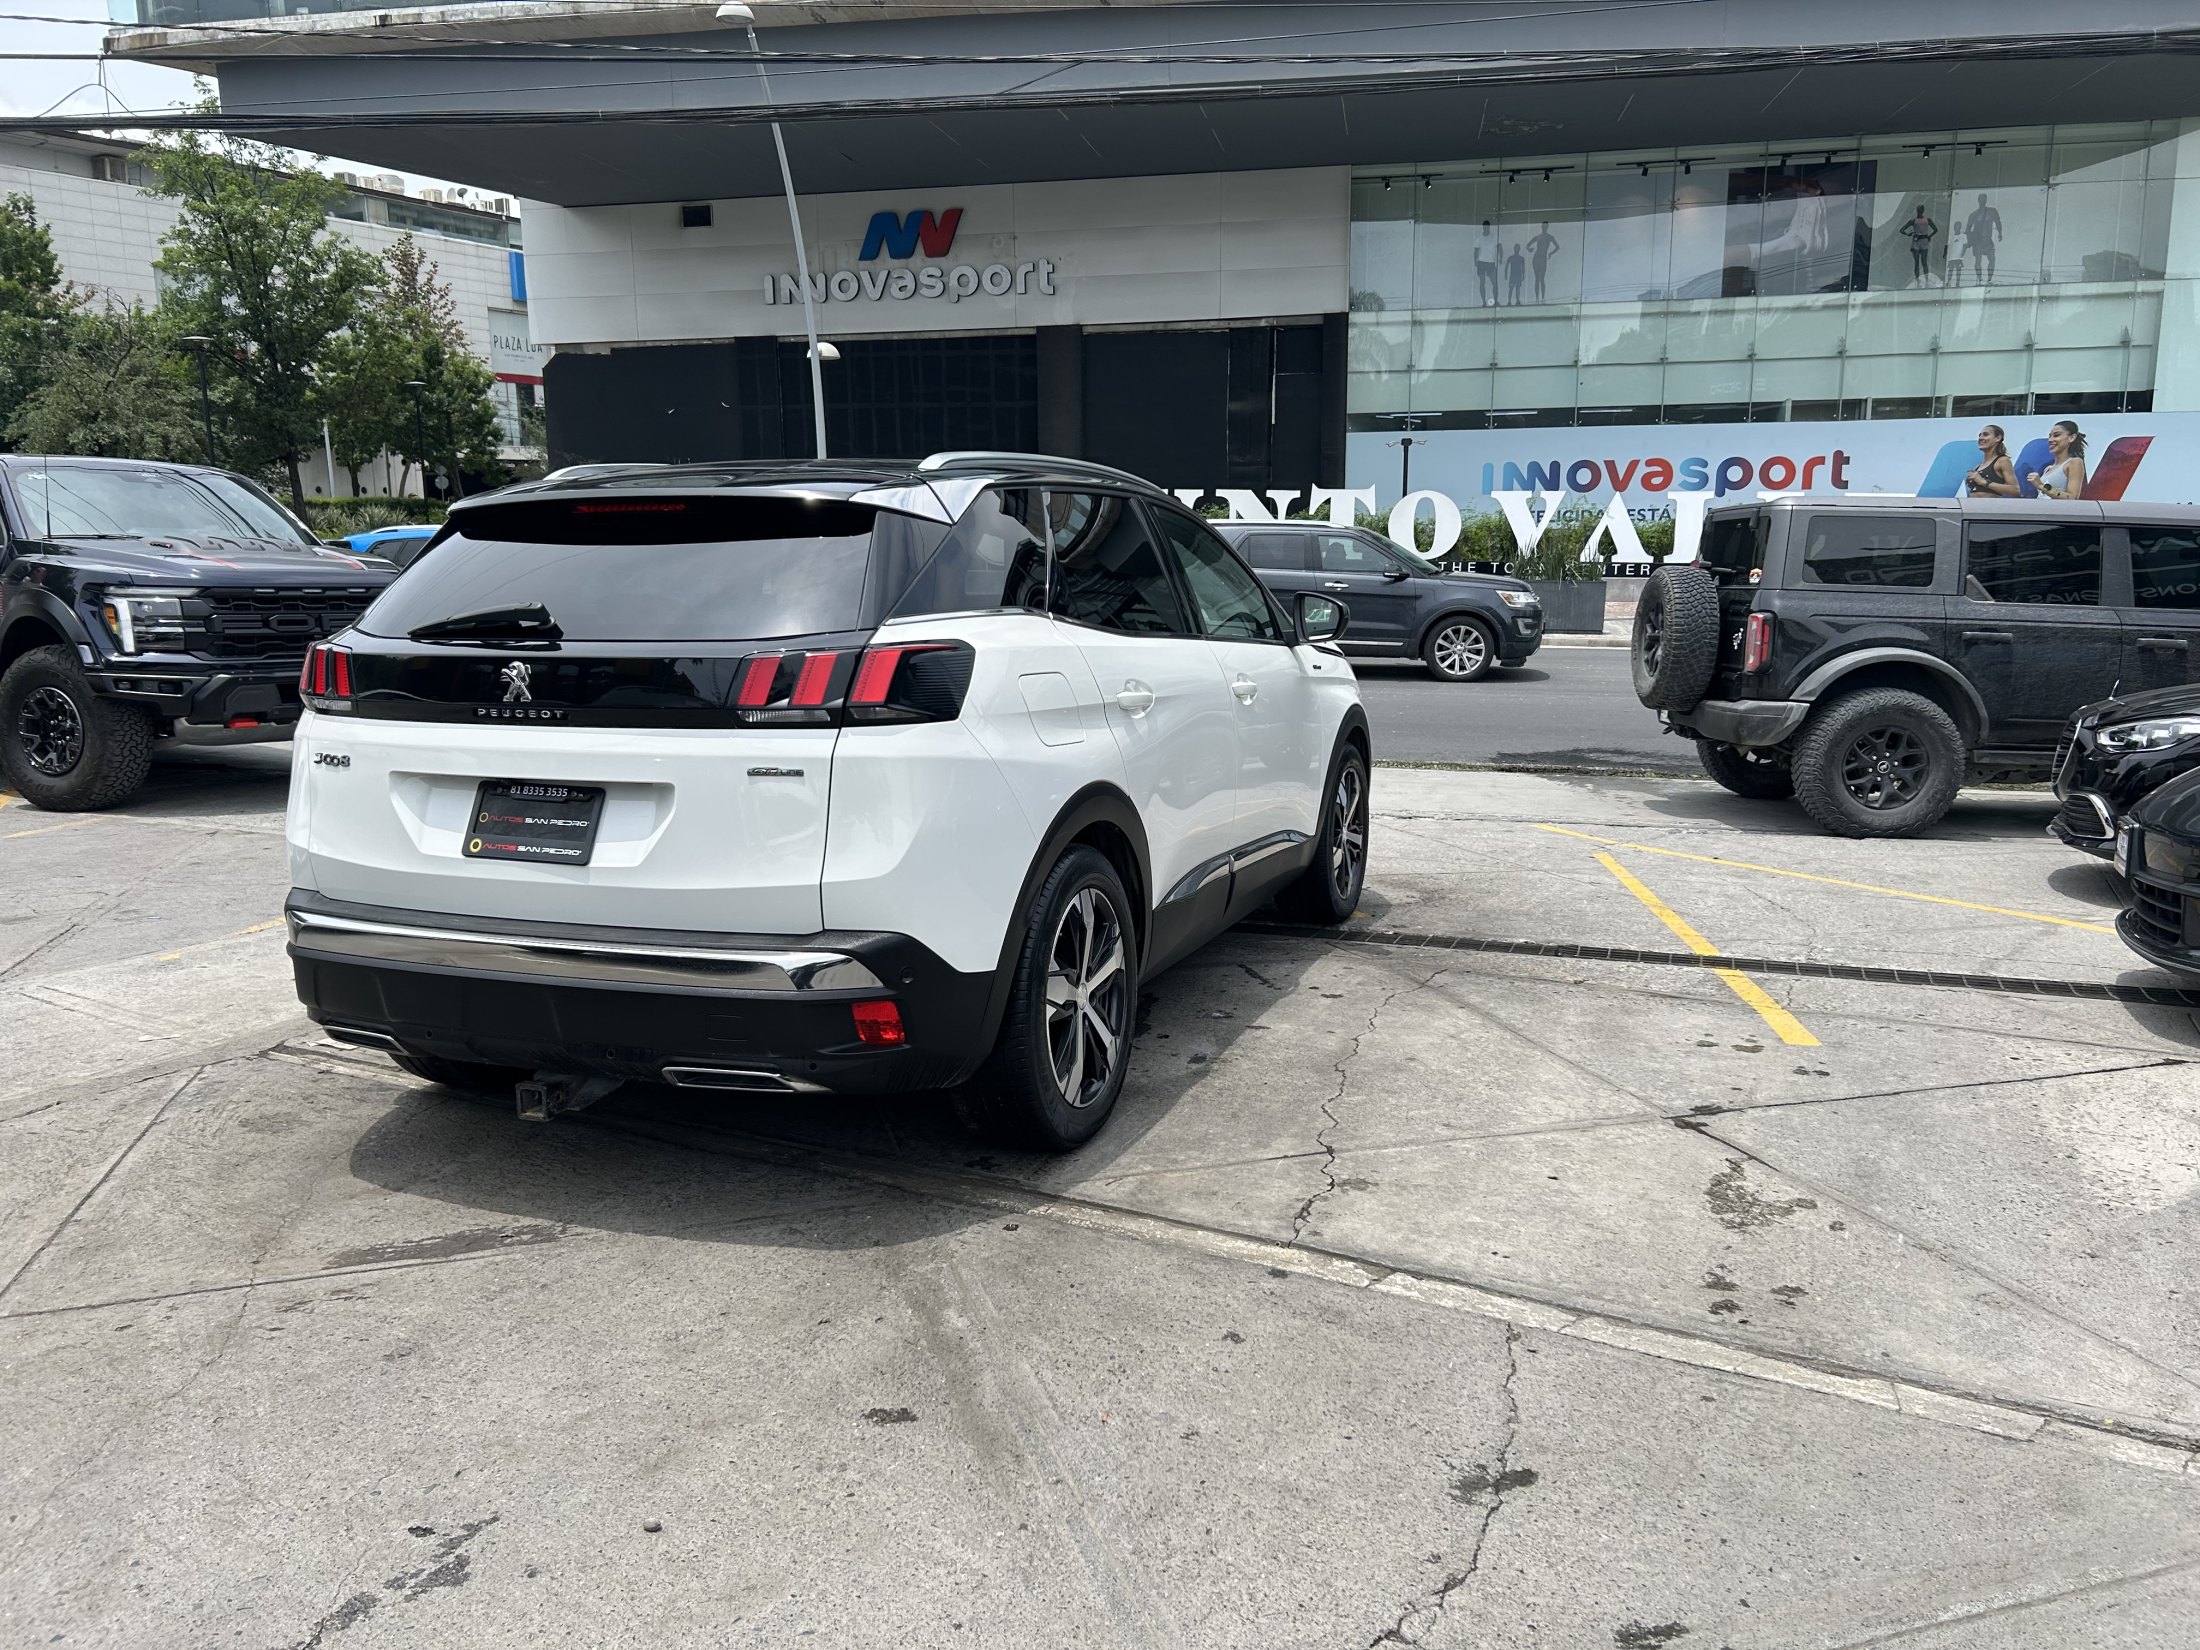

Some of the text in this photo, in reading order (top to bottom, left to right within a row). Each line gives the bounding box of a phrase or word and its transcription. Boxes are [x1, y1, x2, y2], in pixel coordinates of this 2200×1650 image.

[493, 334, 522, 352] PLAZA
[1437, 561, 1476, 574] THE
[477, 708, 564, 719] PEUGEOT
[510, 785, 521, 795] 81
[522, 786, 545, 796] 8335
[546, 787, 569, 798] 3535
[488, 815, 525, 823] AUTOS
[524, 817, 549, 825] SAN
[482, 843, 518, 851] AUTOS
[517, 845, 541, 853] SAN
